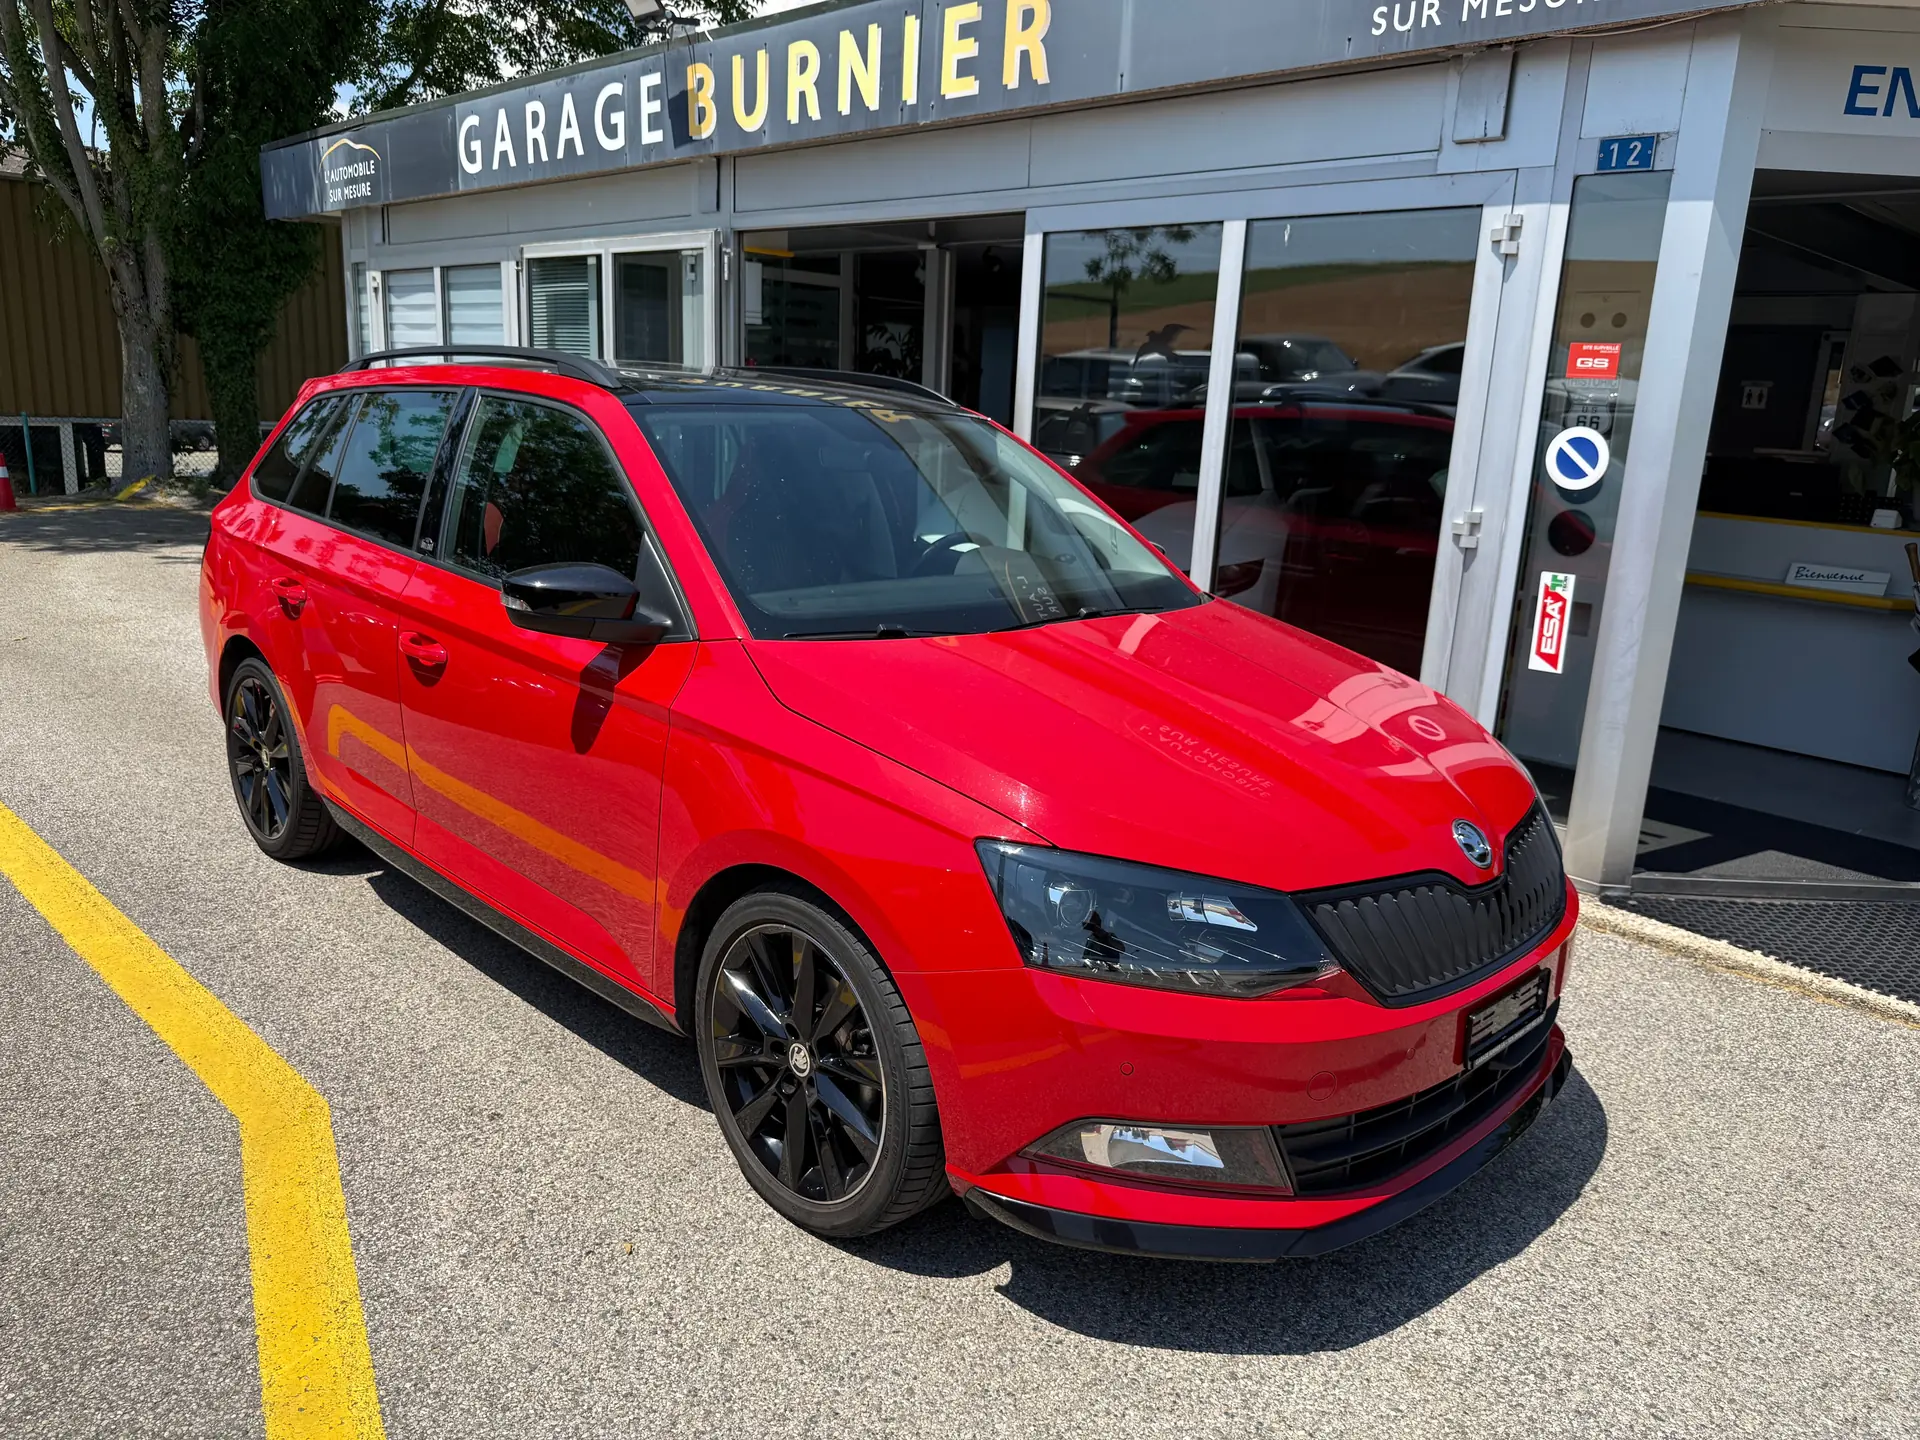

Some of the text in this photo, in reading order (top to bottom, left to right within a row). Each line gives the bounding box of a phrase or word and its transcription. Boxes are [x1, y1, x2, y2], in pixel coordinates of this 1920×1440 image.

[1371, 0, 1441, 36] SUR
[458, 0, 1052, 175] GARAGE BURNIER
[1609, 141, 1642, 167] 12
[324, 160, 376, 184] L'AUTOMOBILE
[329, 181, 372, 203] SUR MESURE
[1576, 357, 1609, 368] GS
[1794, 566, 1865, 581] Bienvenue
